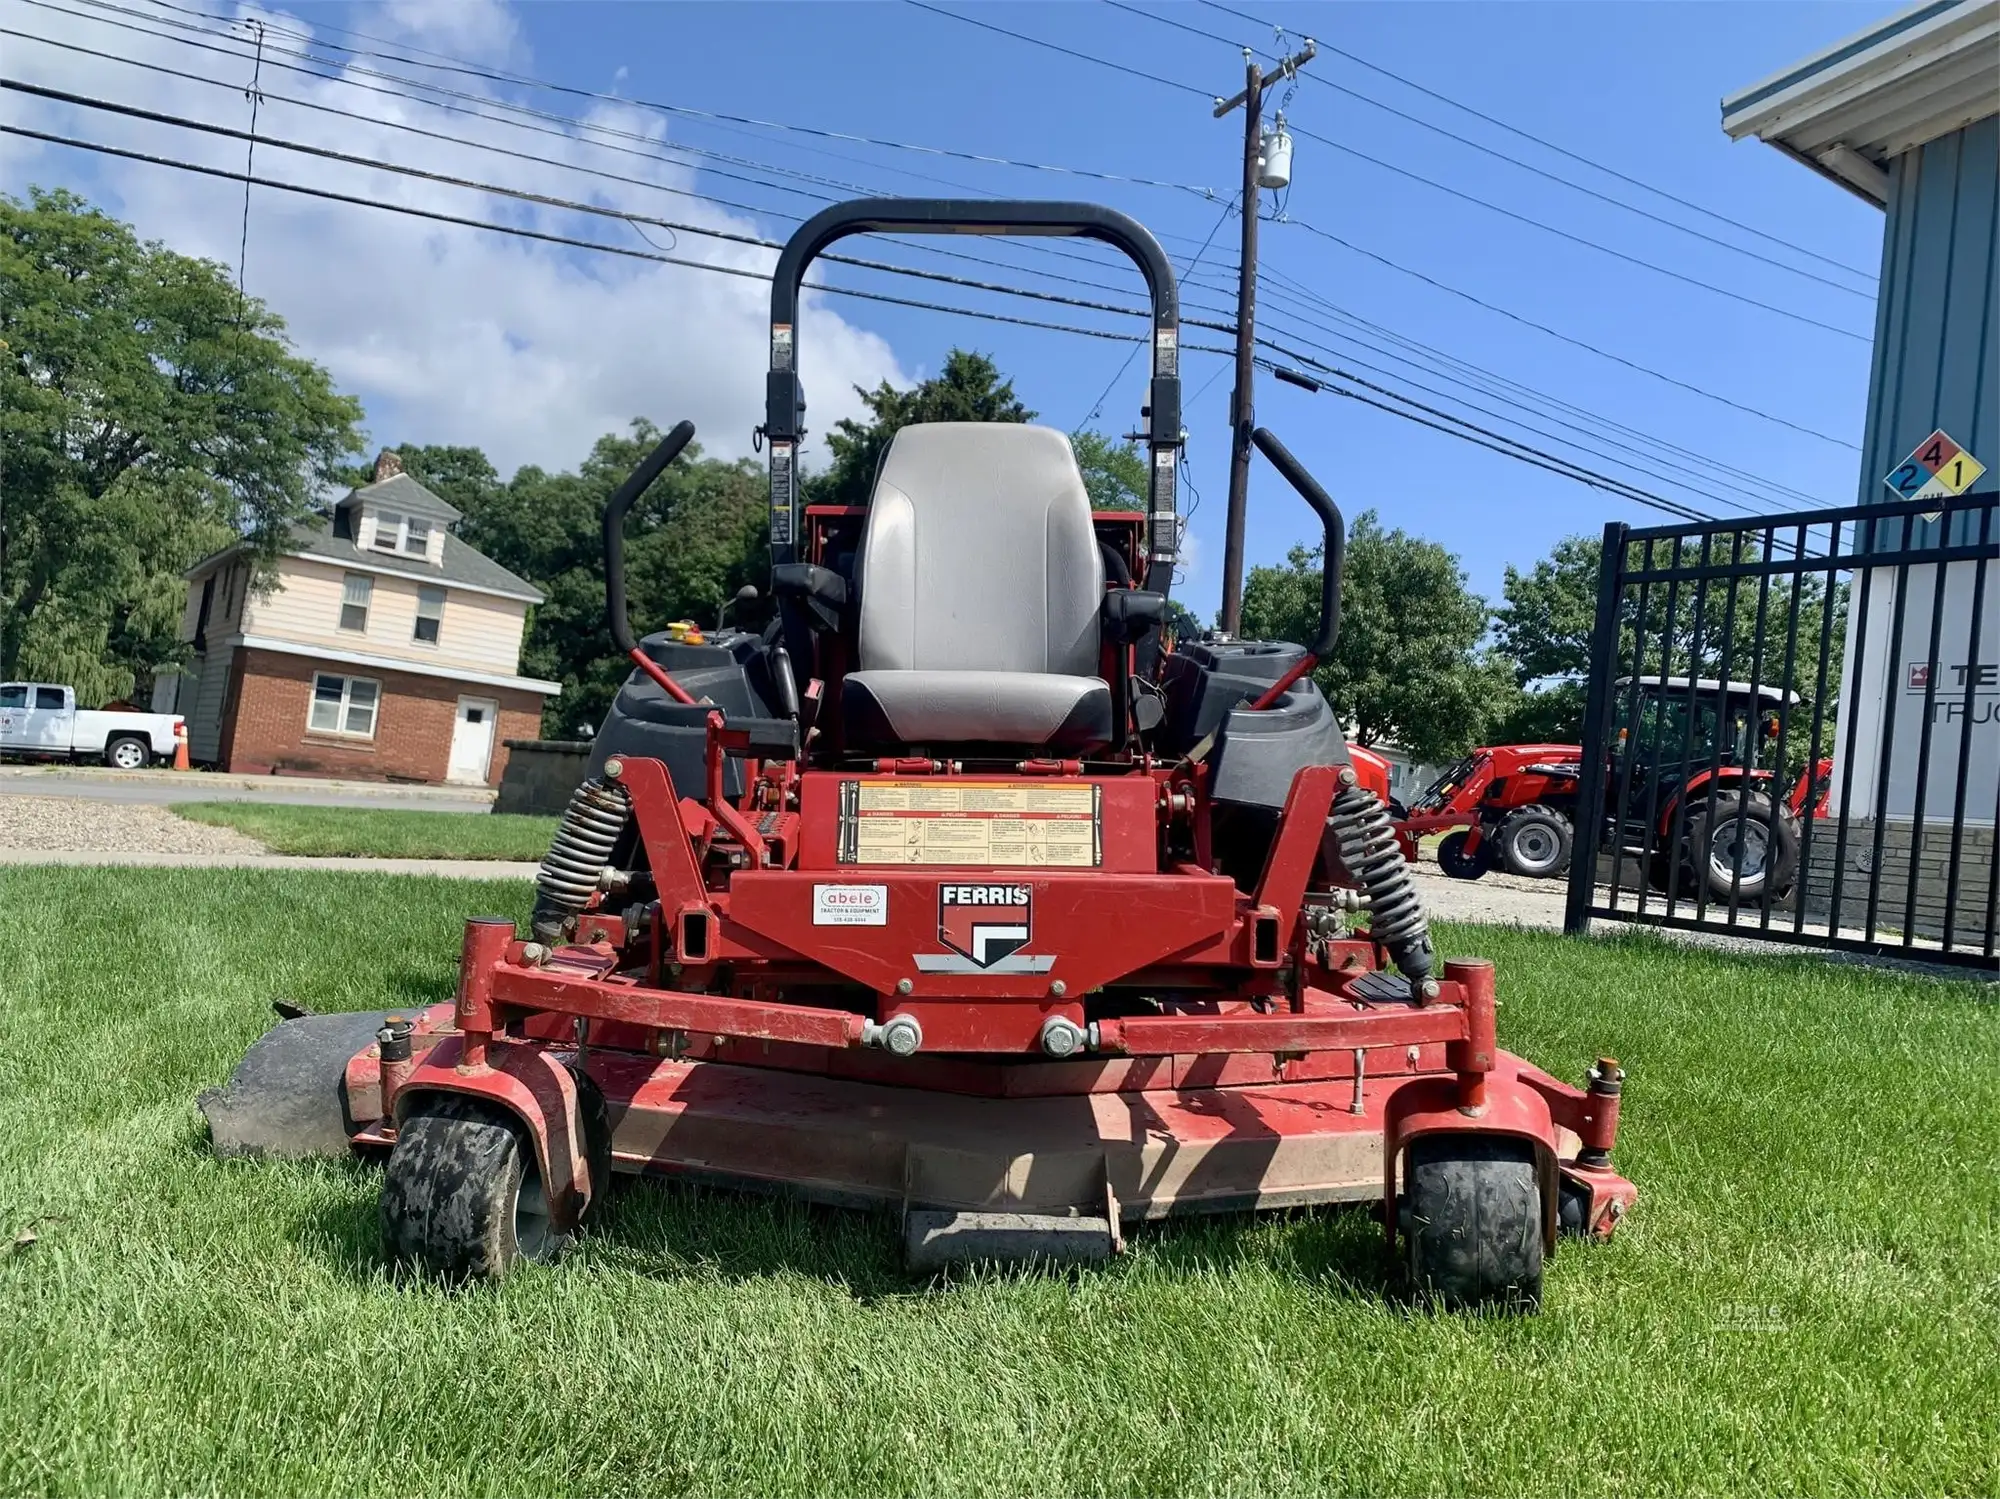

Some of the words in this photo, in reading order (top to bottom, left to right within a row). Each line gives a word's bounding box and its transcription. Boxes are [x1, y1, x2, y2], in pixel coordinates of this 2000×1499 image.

[1922, 440, 1942, 466] 4
[1899, 464, 1919, 492] 2
[1953, 460, 1964, 487] 1
[828, 892, 873, 904] abele
[943, 887, 1029, 905] FERRIS
